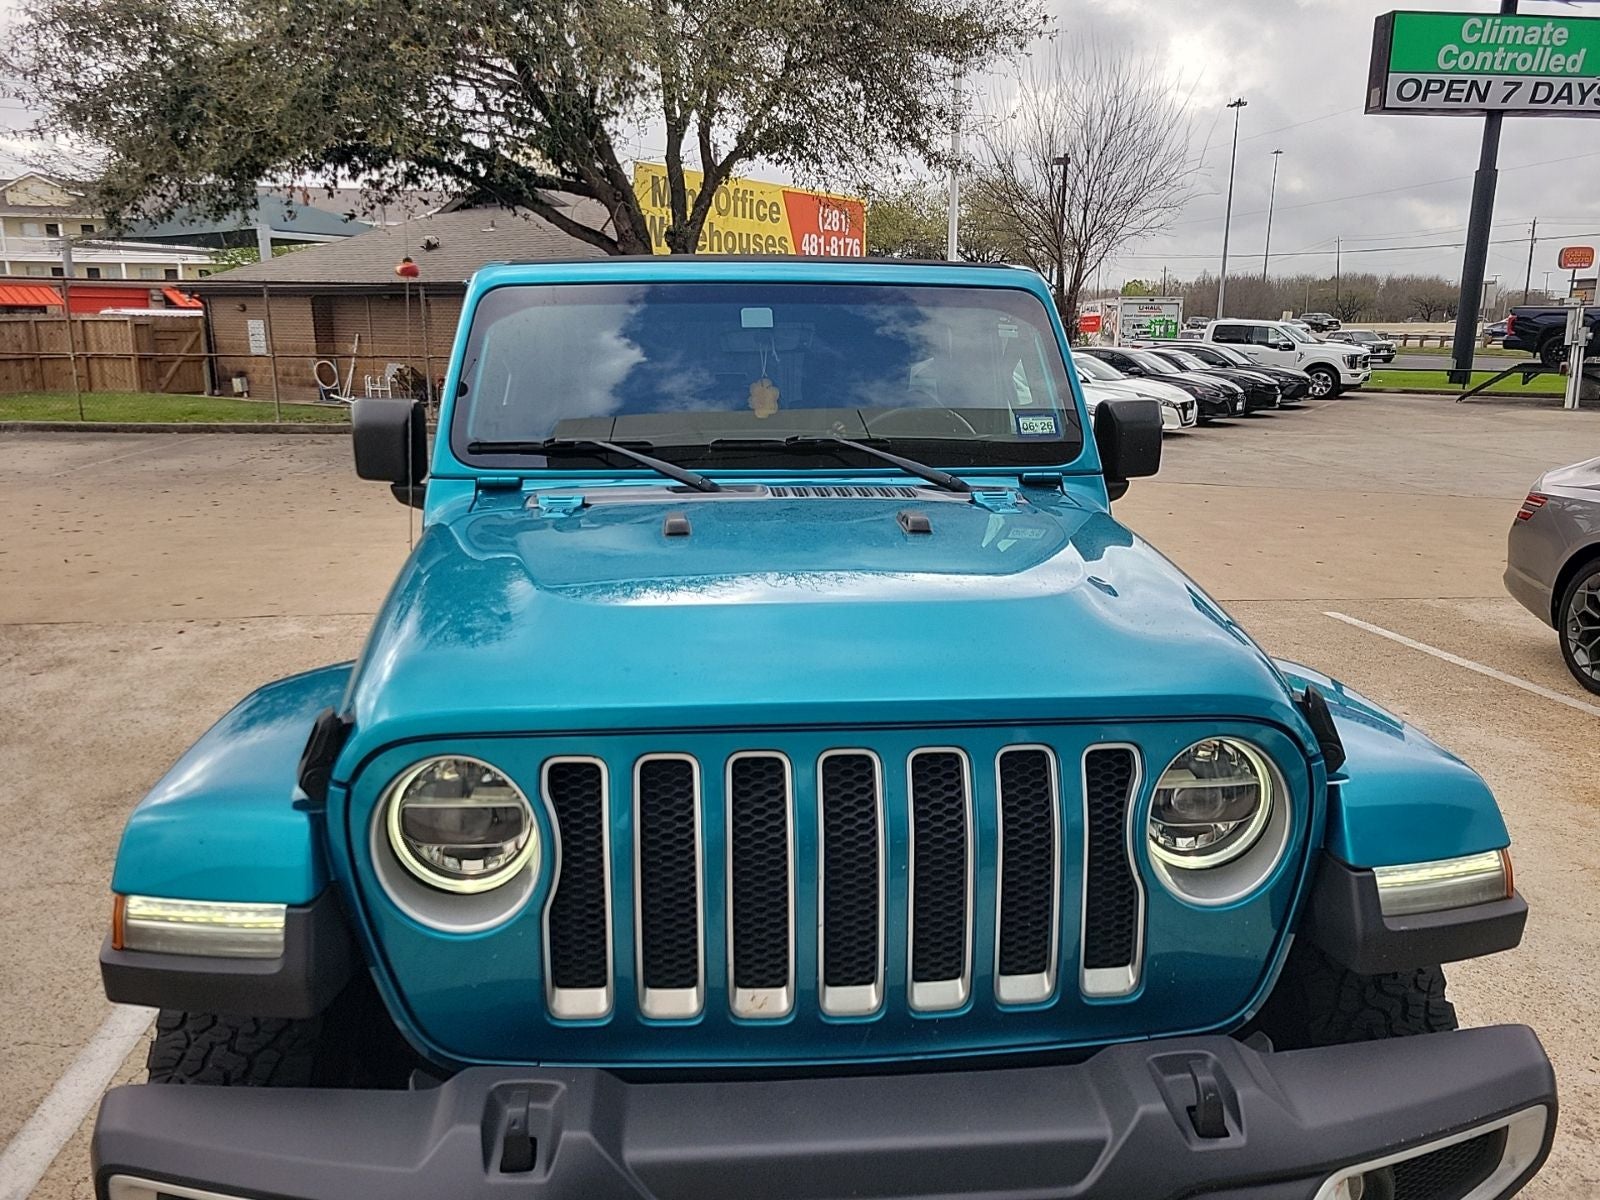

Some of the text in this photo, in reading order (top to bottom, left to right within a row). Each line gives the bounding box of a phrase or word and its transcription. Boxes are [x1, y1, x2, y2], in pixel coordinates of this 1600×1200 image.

[1461, 17, 1569, 46] Climate
[1437, 44, 1587, 73] Controlled
[1395, 78, 1492, 104] OPEN
[1500, 81, 1524, 104] 7
[651, 175, 781, 224] Mn Office
[644, 215, 789, 255] Wehouses
[818, 206, 851, 236] (281)
[801, 233, 861, 258] 481-8176
[1022, 421, 1054, 431] 06 26
